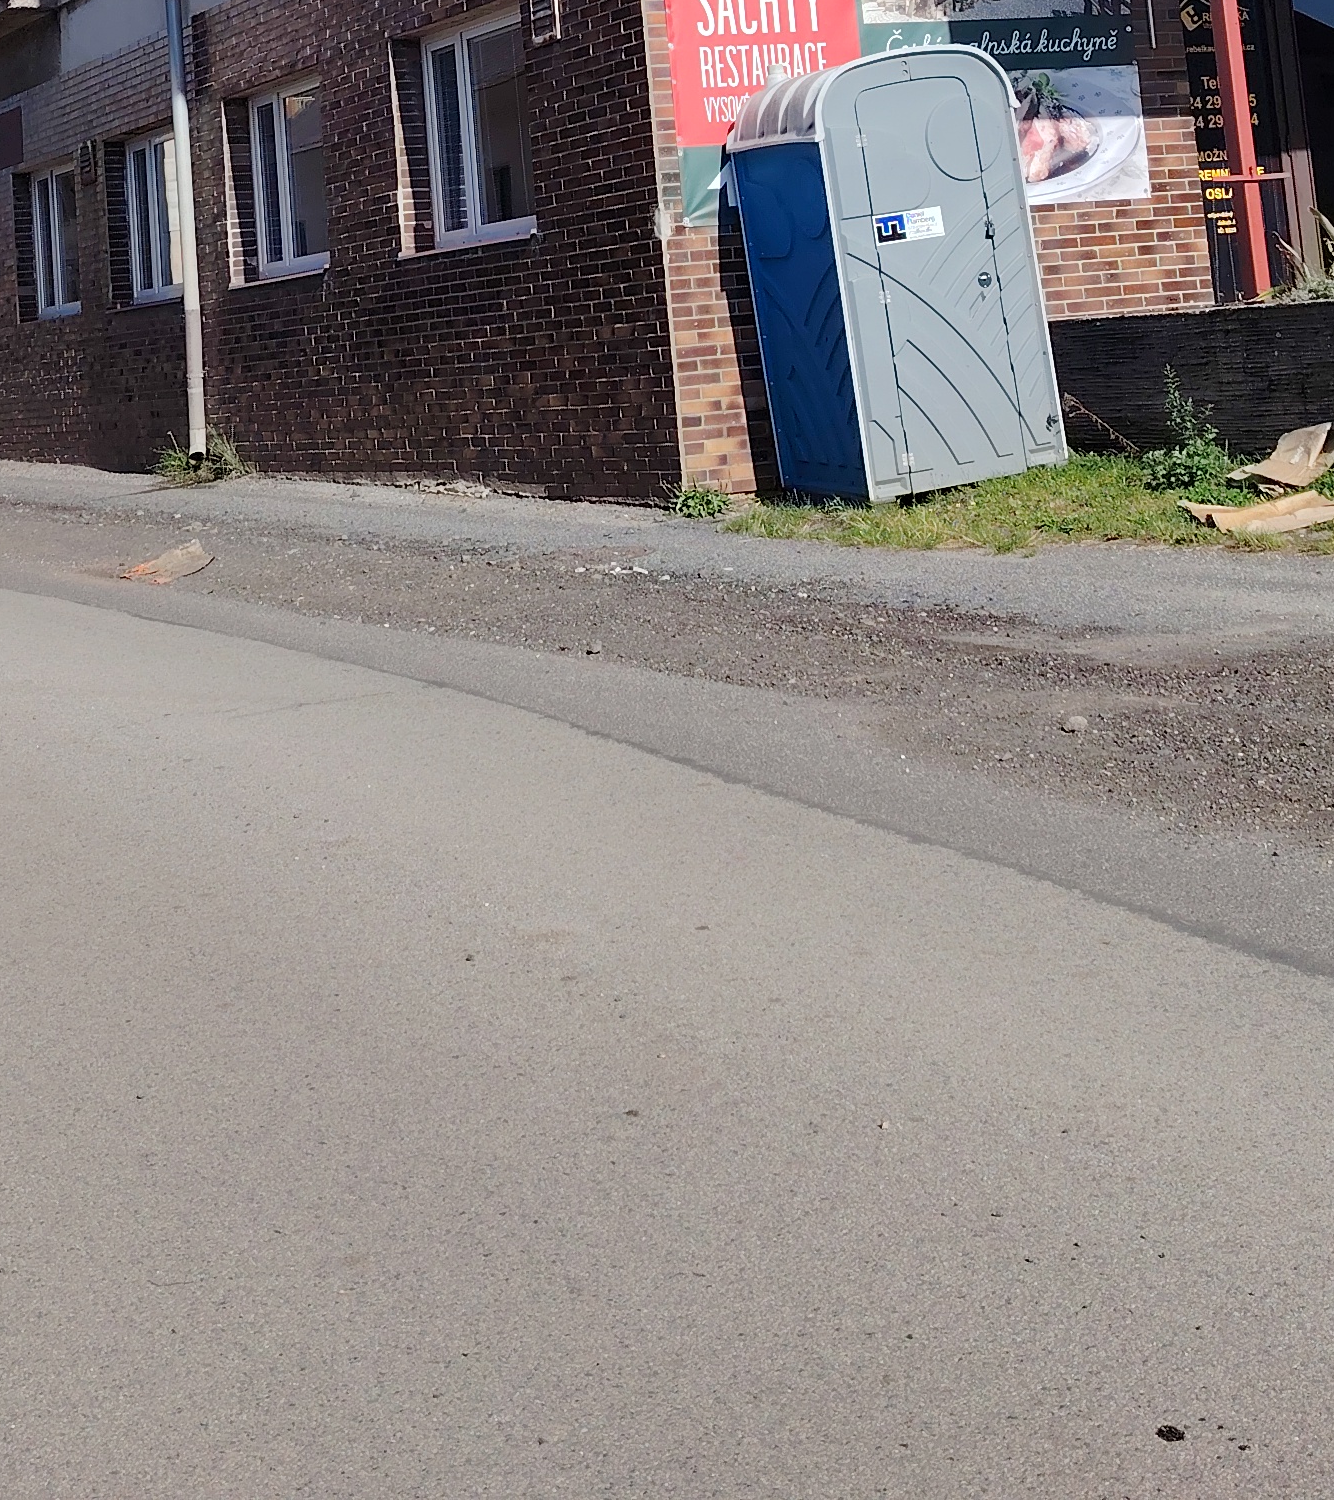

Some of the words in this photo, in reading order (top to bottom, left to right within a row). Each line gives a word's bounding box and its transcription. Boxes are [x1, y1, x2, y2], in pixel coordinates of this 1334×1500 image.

[1034, 28, 1119, 61] kuchyně
[1205, 95, 1222, 109] 29
[1208, 114, 1224, 128] 29
